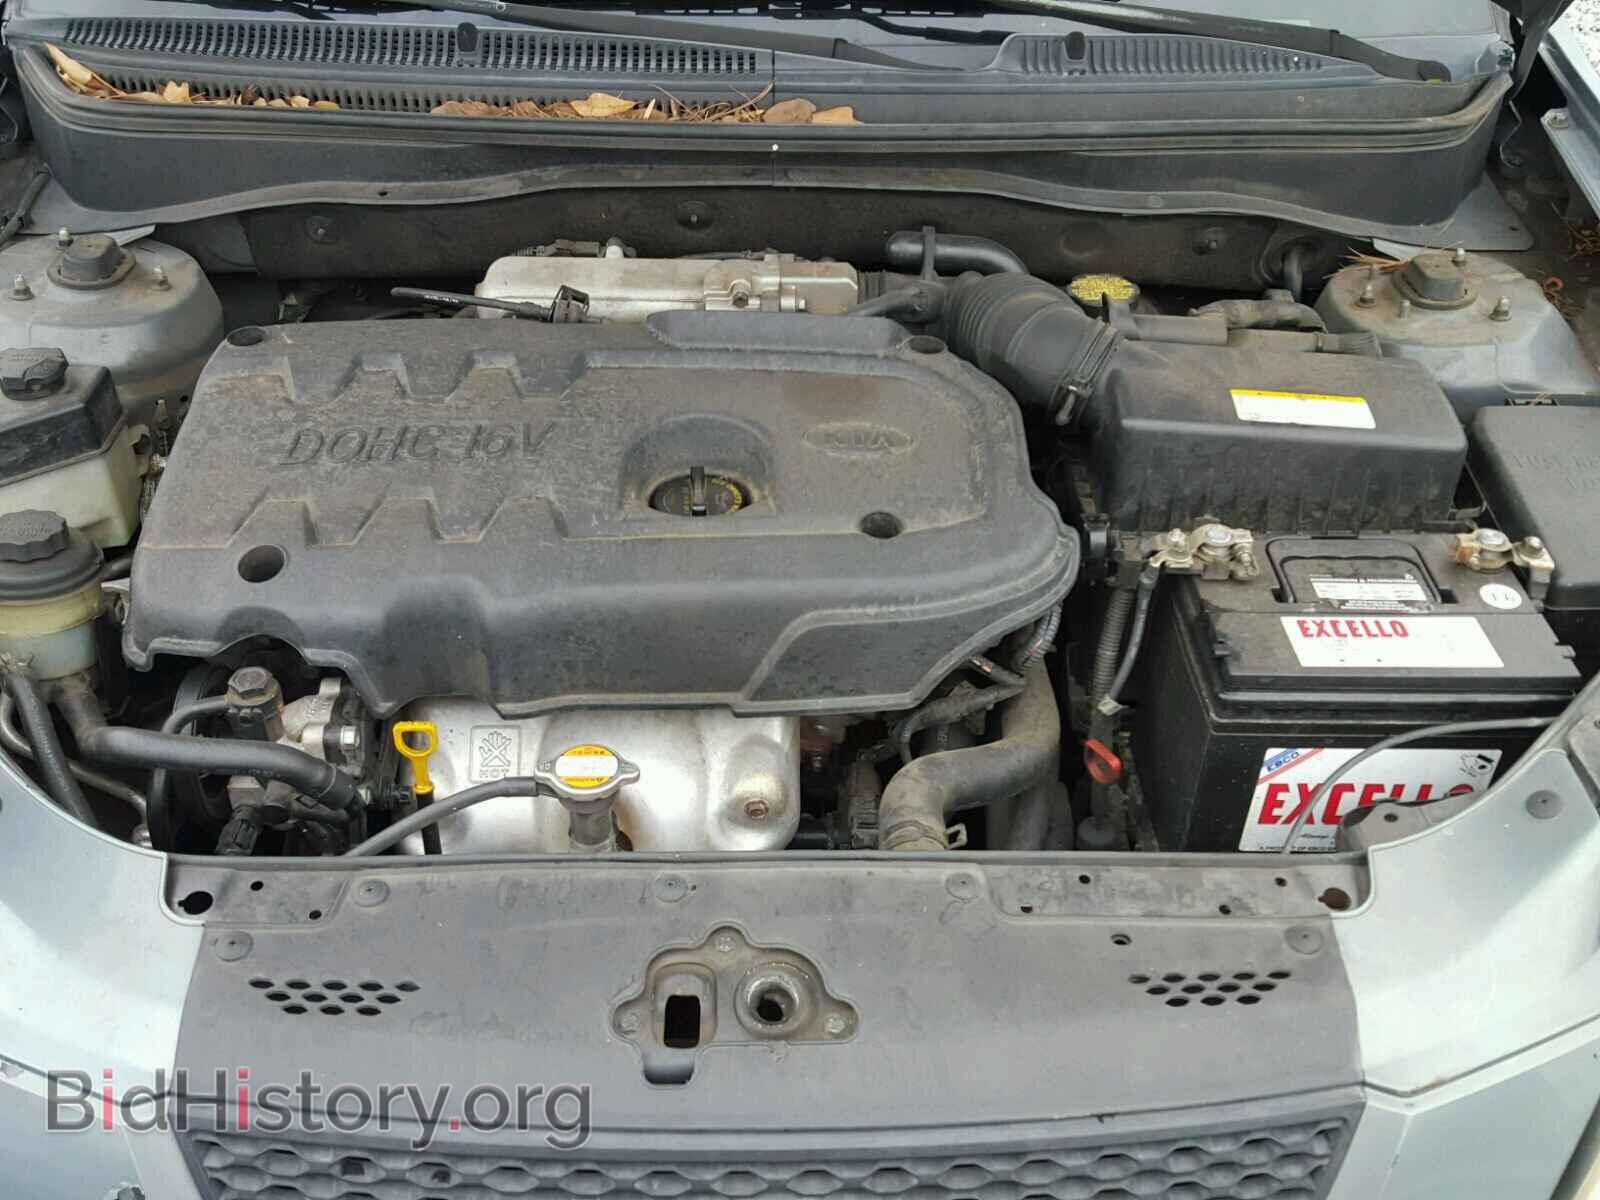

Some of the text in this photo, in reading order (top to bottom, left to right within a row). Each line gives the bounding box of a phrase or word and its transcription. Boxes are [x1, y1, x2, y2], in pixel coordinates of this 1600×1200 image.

[279, 421, 555, 466] DOHC 16V
[1295, 618, 1410, 640] EXCELLO
